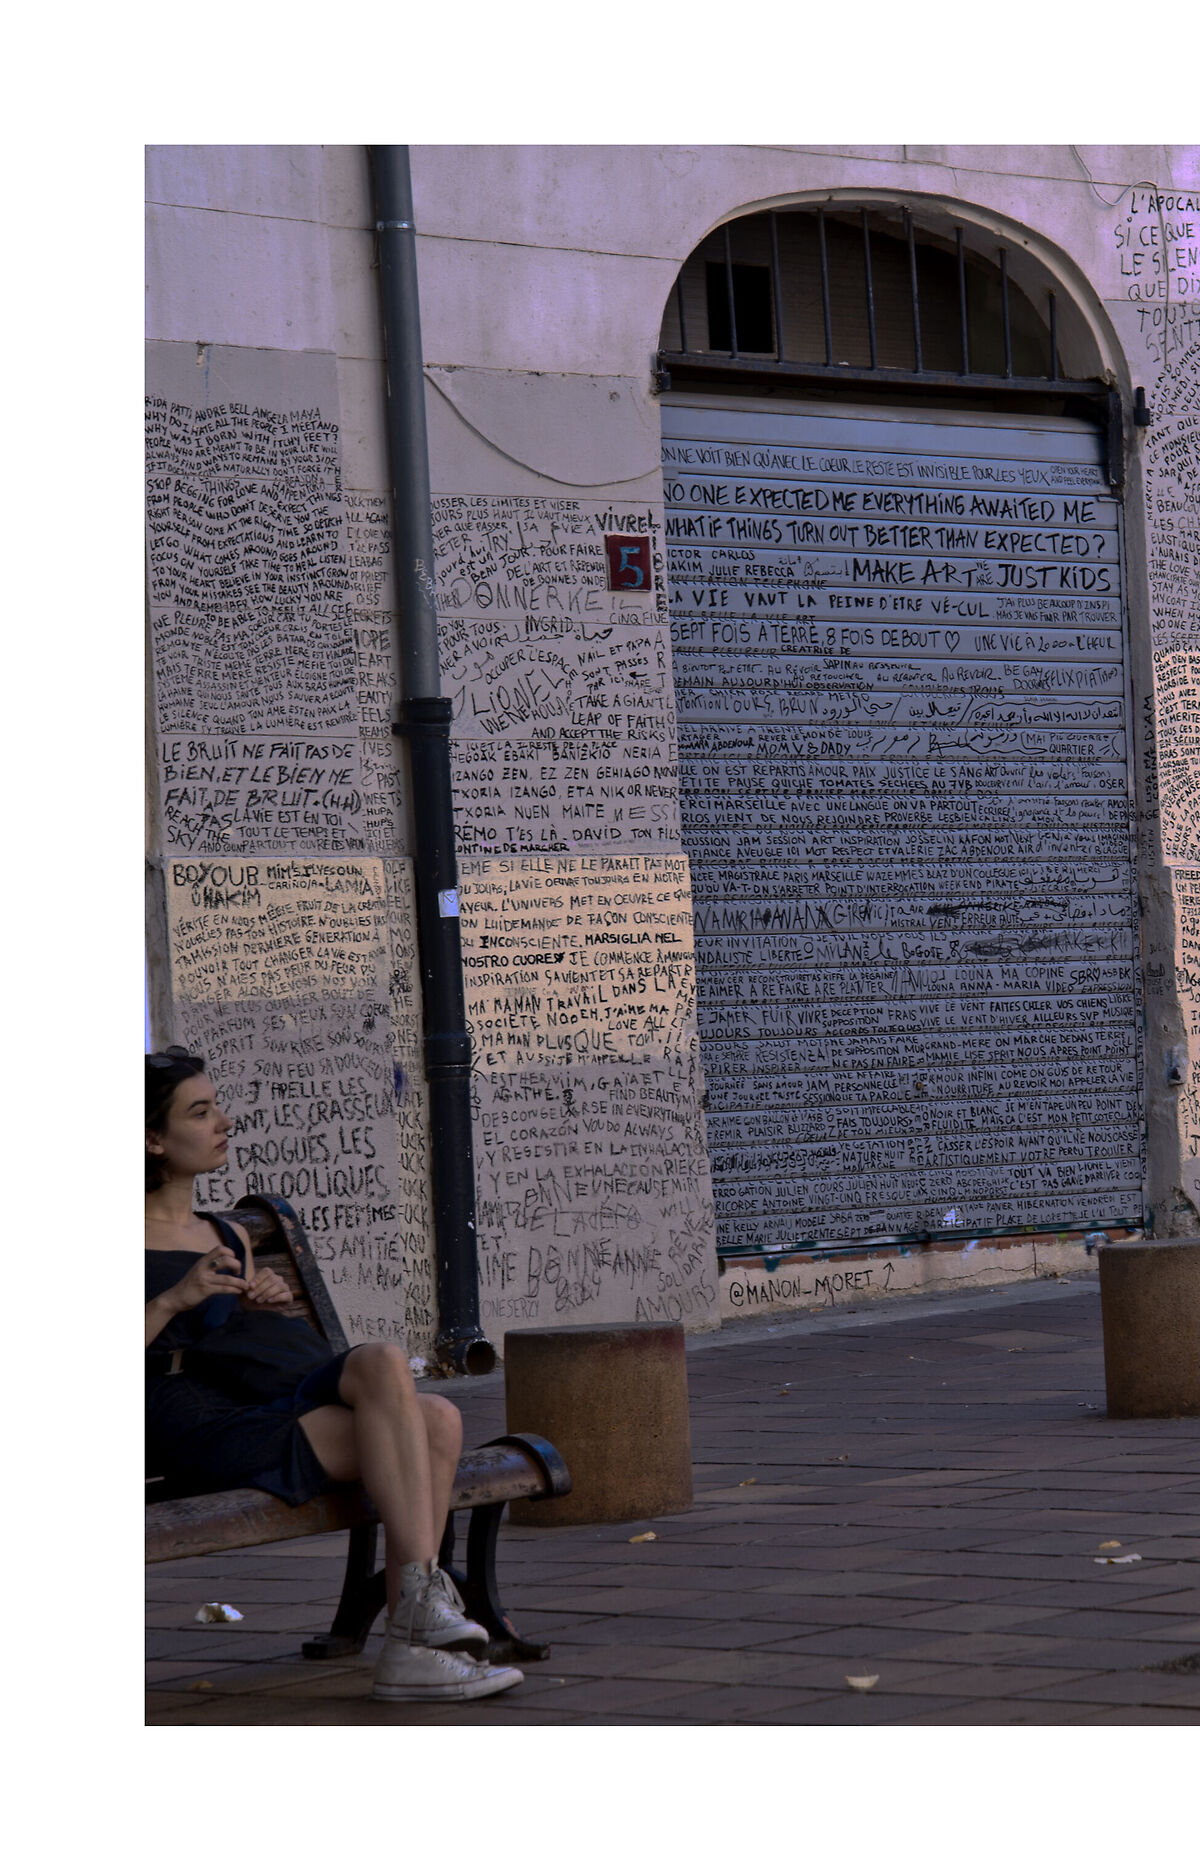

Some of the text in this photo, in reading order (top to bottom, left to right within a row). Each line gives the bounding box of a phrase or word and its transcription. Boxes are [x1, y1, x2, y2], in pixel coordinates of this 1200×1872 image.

[1139, 226, 1159, 245] CE
[1165, 219, 1194, 242] QUE
[1119, 253, 1142, 276] LE
[678, 448, 695, 464] NE
[725, 449, 751, 467] BIEN
[754, 449, 797, 470] QU'AVEC
[802, 457, 818, 471] LE
[820, 457, 851, 472] COEUR
[853, 460, 864, 473] LE
[866, 461, 894, 476] RESTE
[898, 461, 915, 478] EST
[973, 465, 999, 482] POUR
[1000, 467, 1015, 483] LES
[1018, 468, 1050, 486] YEUX
[690, 484, 1096, 524] ONE EXPECTED ME EVERYTHING AWAITED ME
[595, 506, 648, 533] VIVRE
[665, 515, 707, 538] WHAT
[726, 517, 782, 544] THINGS
[786, 521, 824, 545] TURN
[829, 525, 859, 548] OUT
[863, 523, 934, 551] BETTER
[935, 527, 978, 550] THAN
[712, 550, 755, 560] CARLOS
[619, 547, 644, 587] 5
[709, 564, 795, 578] JULIE REBECCA
[853, 556, 916, 585] MAKE
[921, 558, 977, 588] ART
[996, 563, 1057, 589] JUST
[1060, 566, 1112, 592] KIDS
[693, 589, 729, 607] VIE
[744, 591, 788, 608] VAUT
[798, 593, 817, 608] LA
[829, 594, 874, 609] PEINE
[671, 621, 705, 642] SEPT
[712, 623, 750, 645] FOIS
[826, 627, 836, 645] 8
[841, 628, 874, 646] FOIS
[881, 629, 942, 649] DEBOUT
[823, 658, 851, 671] SAPIN
[576, 693, 664, 709] TAKE GIANT
[571, 712, 665, 728] LEAP OF FAITH
[531, 728, 555, 740] AND
[560, 728, 596, 740] ACCEPT
[599, 730, 622, 740] THE
[162, 738, 354, 763] LE BRUIT NE FAIT PAS DE
[504, 751, 539, 762] EBAKI
[552, 750, 611, 761] BANIZKIO
[623, 748, 662, 759] NERIA
[222, 763, 353, 786] ET LE BIEN NE
[808, 766, 876, 778] AMOUR PAIX
[771, 778, 874, 790] QUICHE TOMATES
[214, 789, 240, 807] DE
[715, 800, 820, 813] MARSEILLE AVEC
[454, 803, 605, 820] TXORIA NUEN MAITE
[506, 826, 651, 841] T'ES DAVID TON
[766, 836, 900, 846] SESSION ART INSPIRATION
[501, 896, 613, 911] L'UNIVERS MET EN
[585, 932, 682, 945] MARSIGLIA NEL
[339, 1125, 376, 1160] LES
[196, 1174, 236, 1206] LES
[729, 1269, 873, 1306] @MANON_MORET
